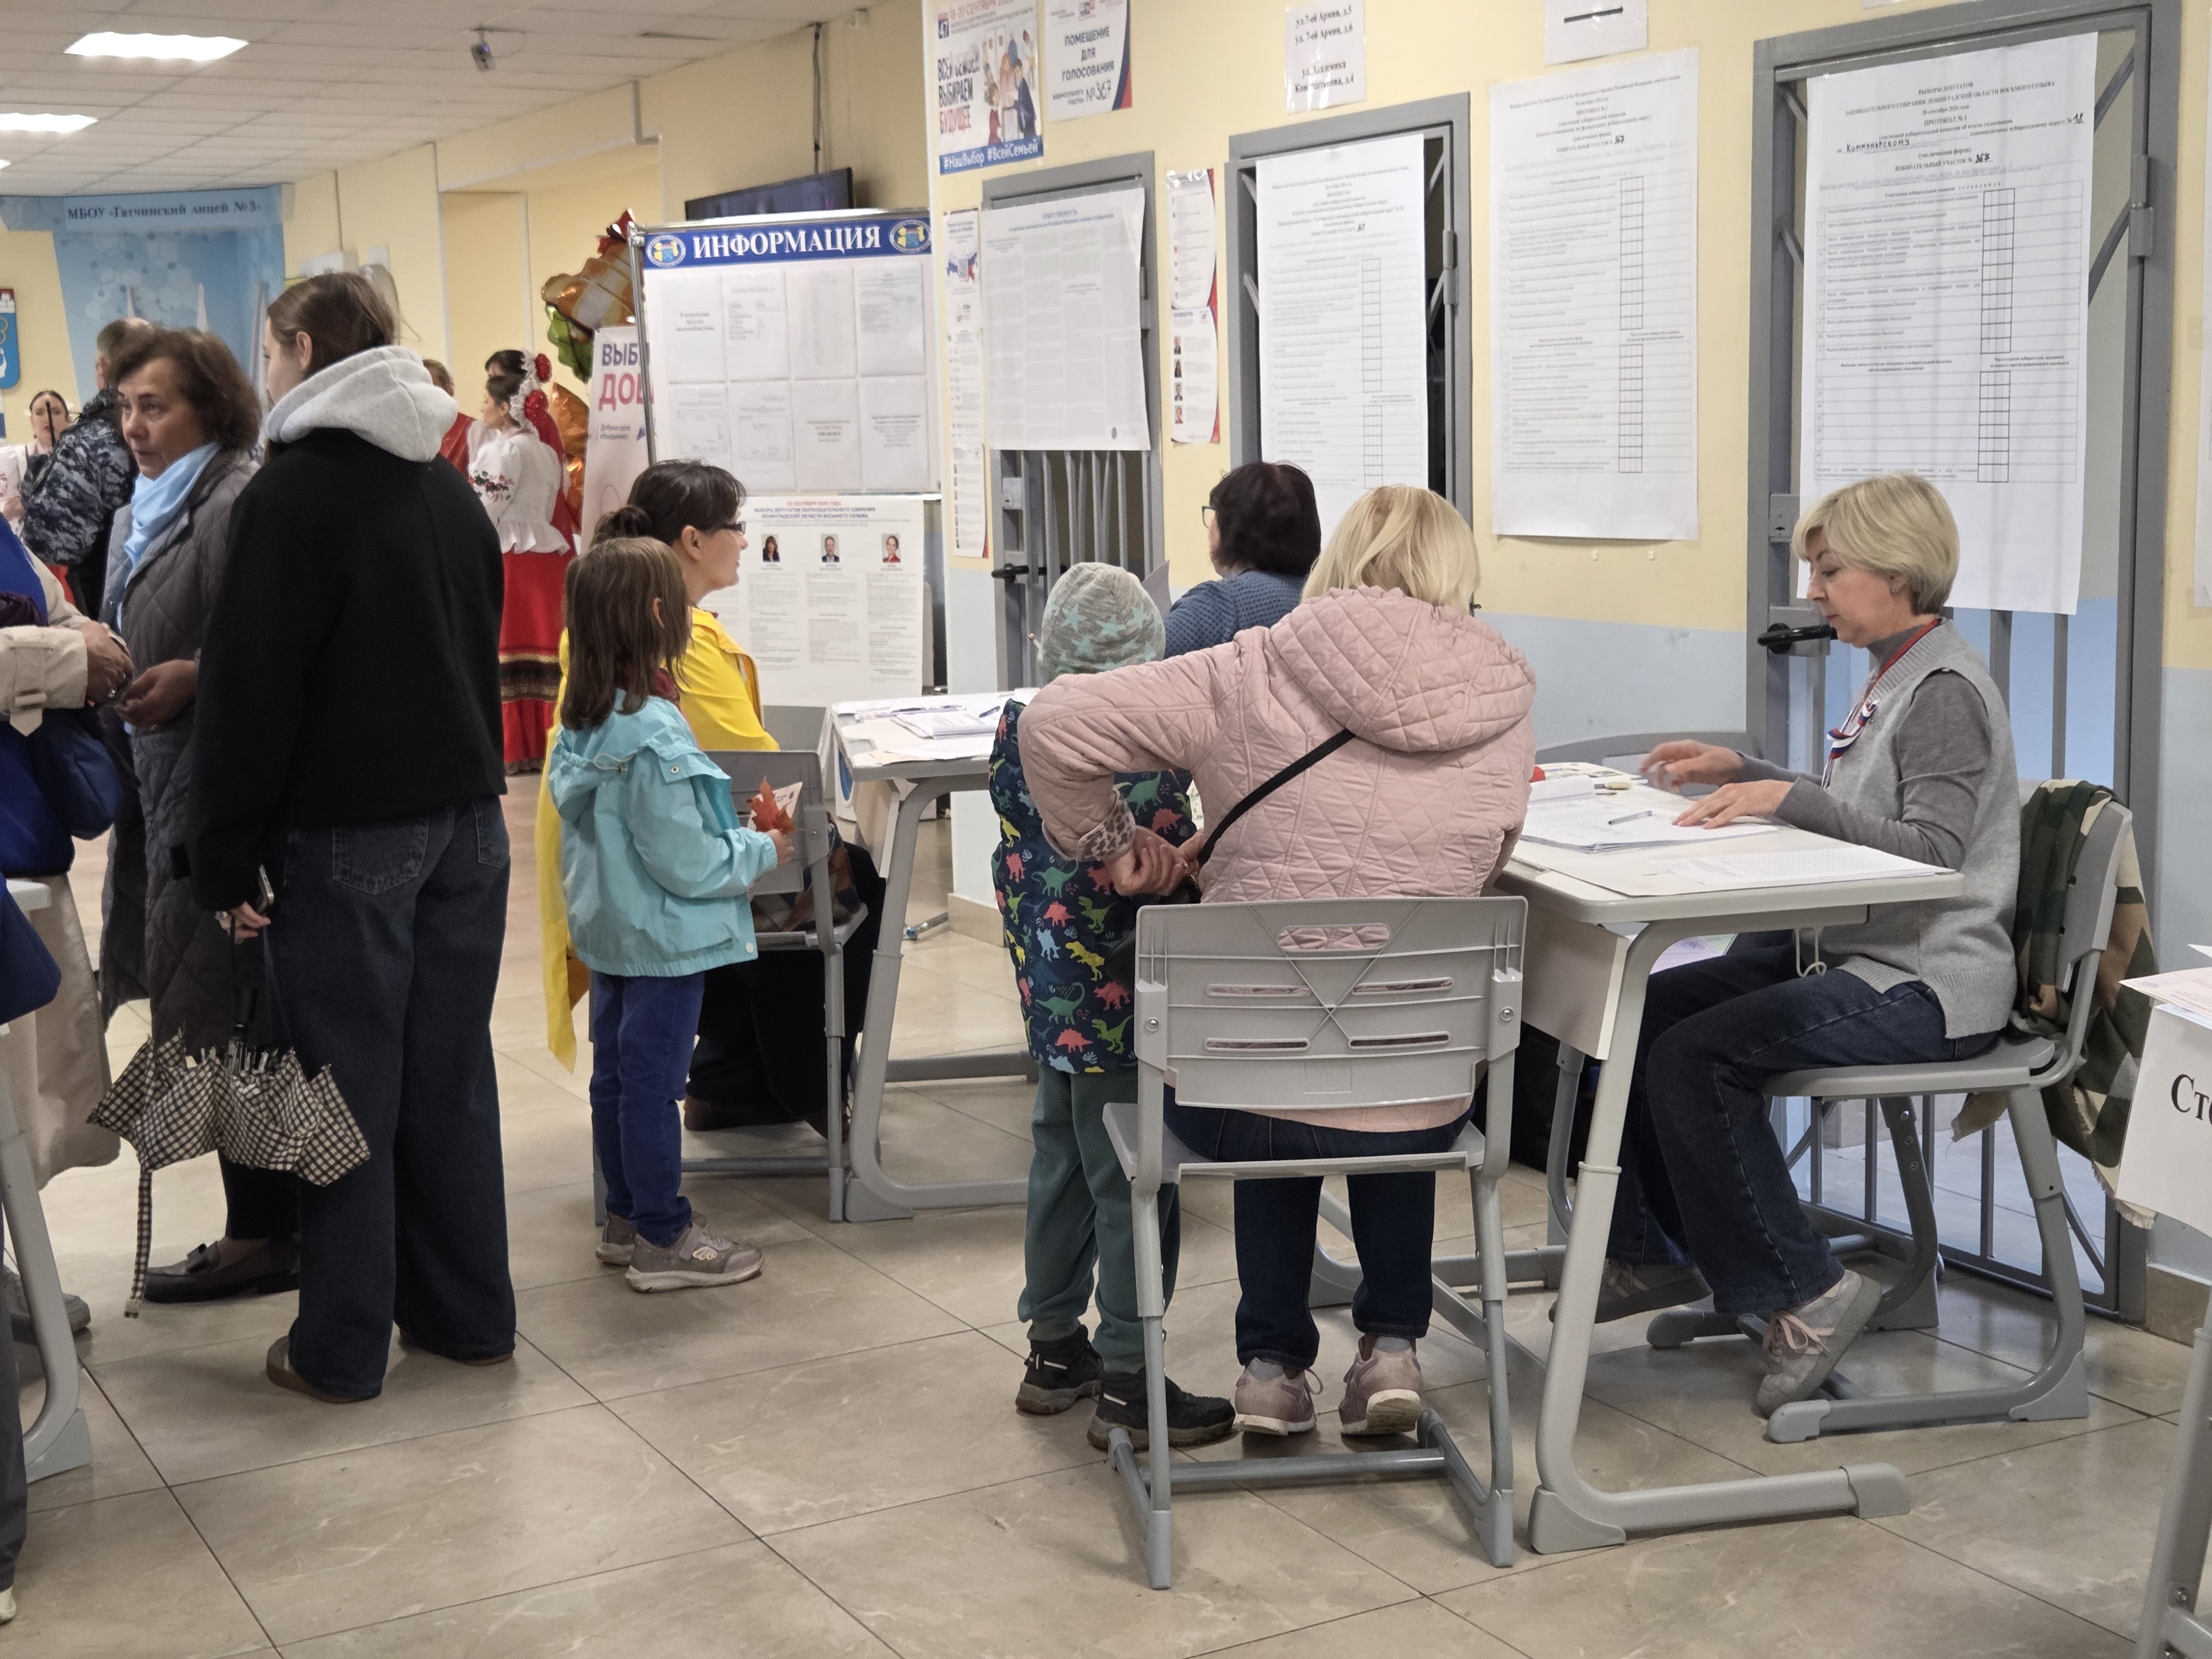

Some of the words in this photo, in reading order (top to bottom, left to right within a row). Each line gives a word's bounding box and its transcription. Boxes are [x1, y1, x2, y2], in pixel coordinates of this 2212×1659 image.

[1065, 26, 1110, 47] ПОМЕЩЕНИЕ
[1081, 47, 1096, 62] ДЛЯ
[1062, 60, 1115, 82] ГОЛОСОВАНИЯ
[944, 150, 985, 170] #НашВыбор
[67, 207, 105, 220] МБОУ
[192, 202, 229, 215] лицей
[692, 226, 882, 259] ИНФОРМАЦИЯ
